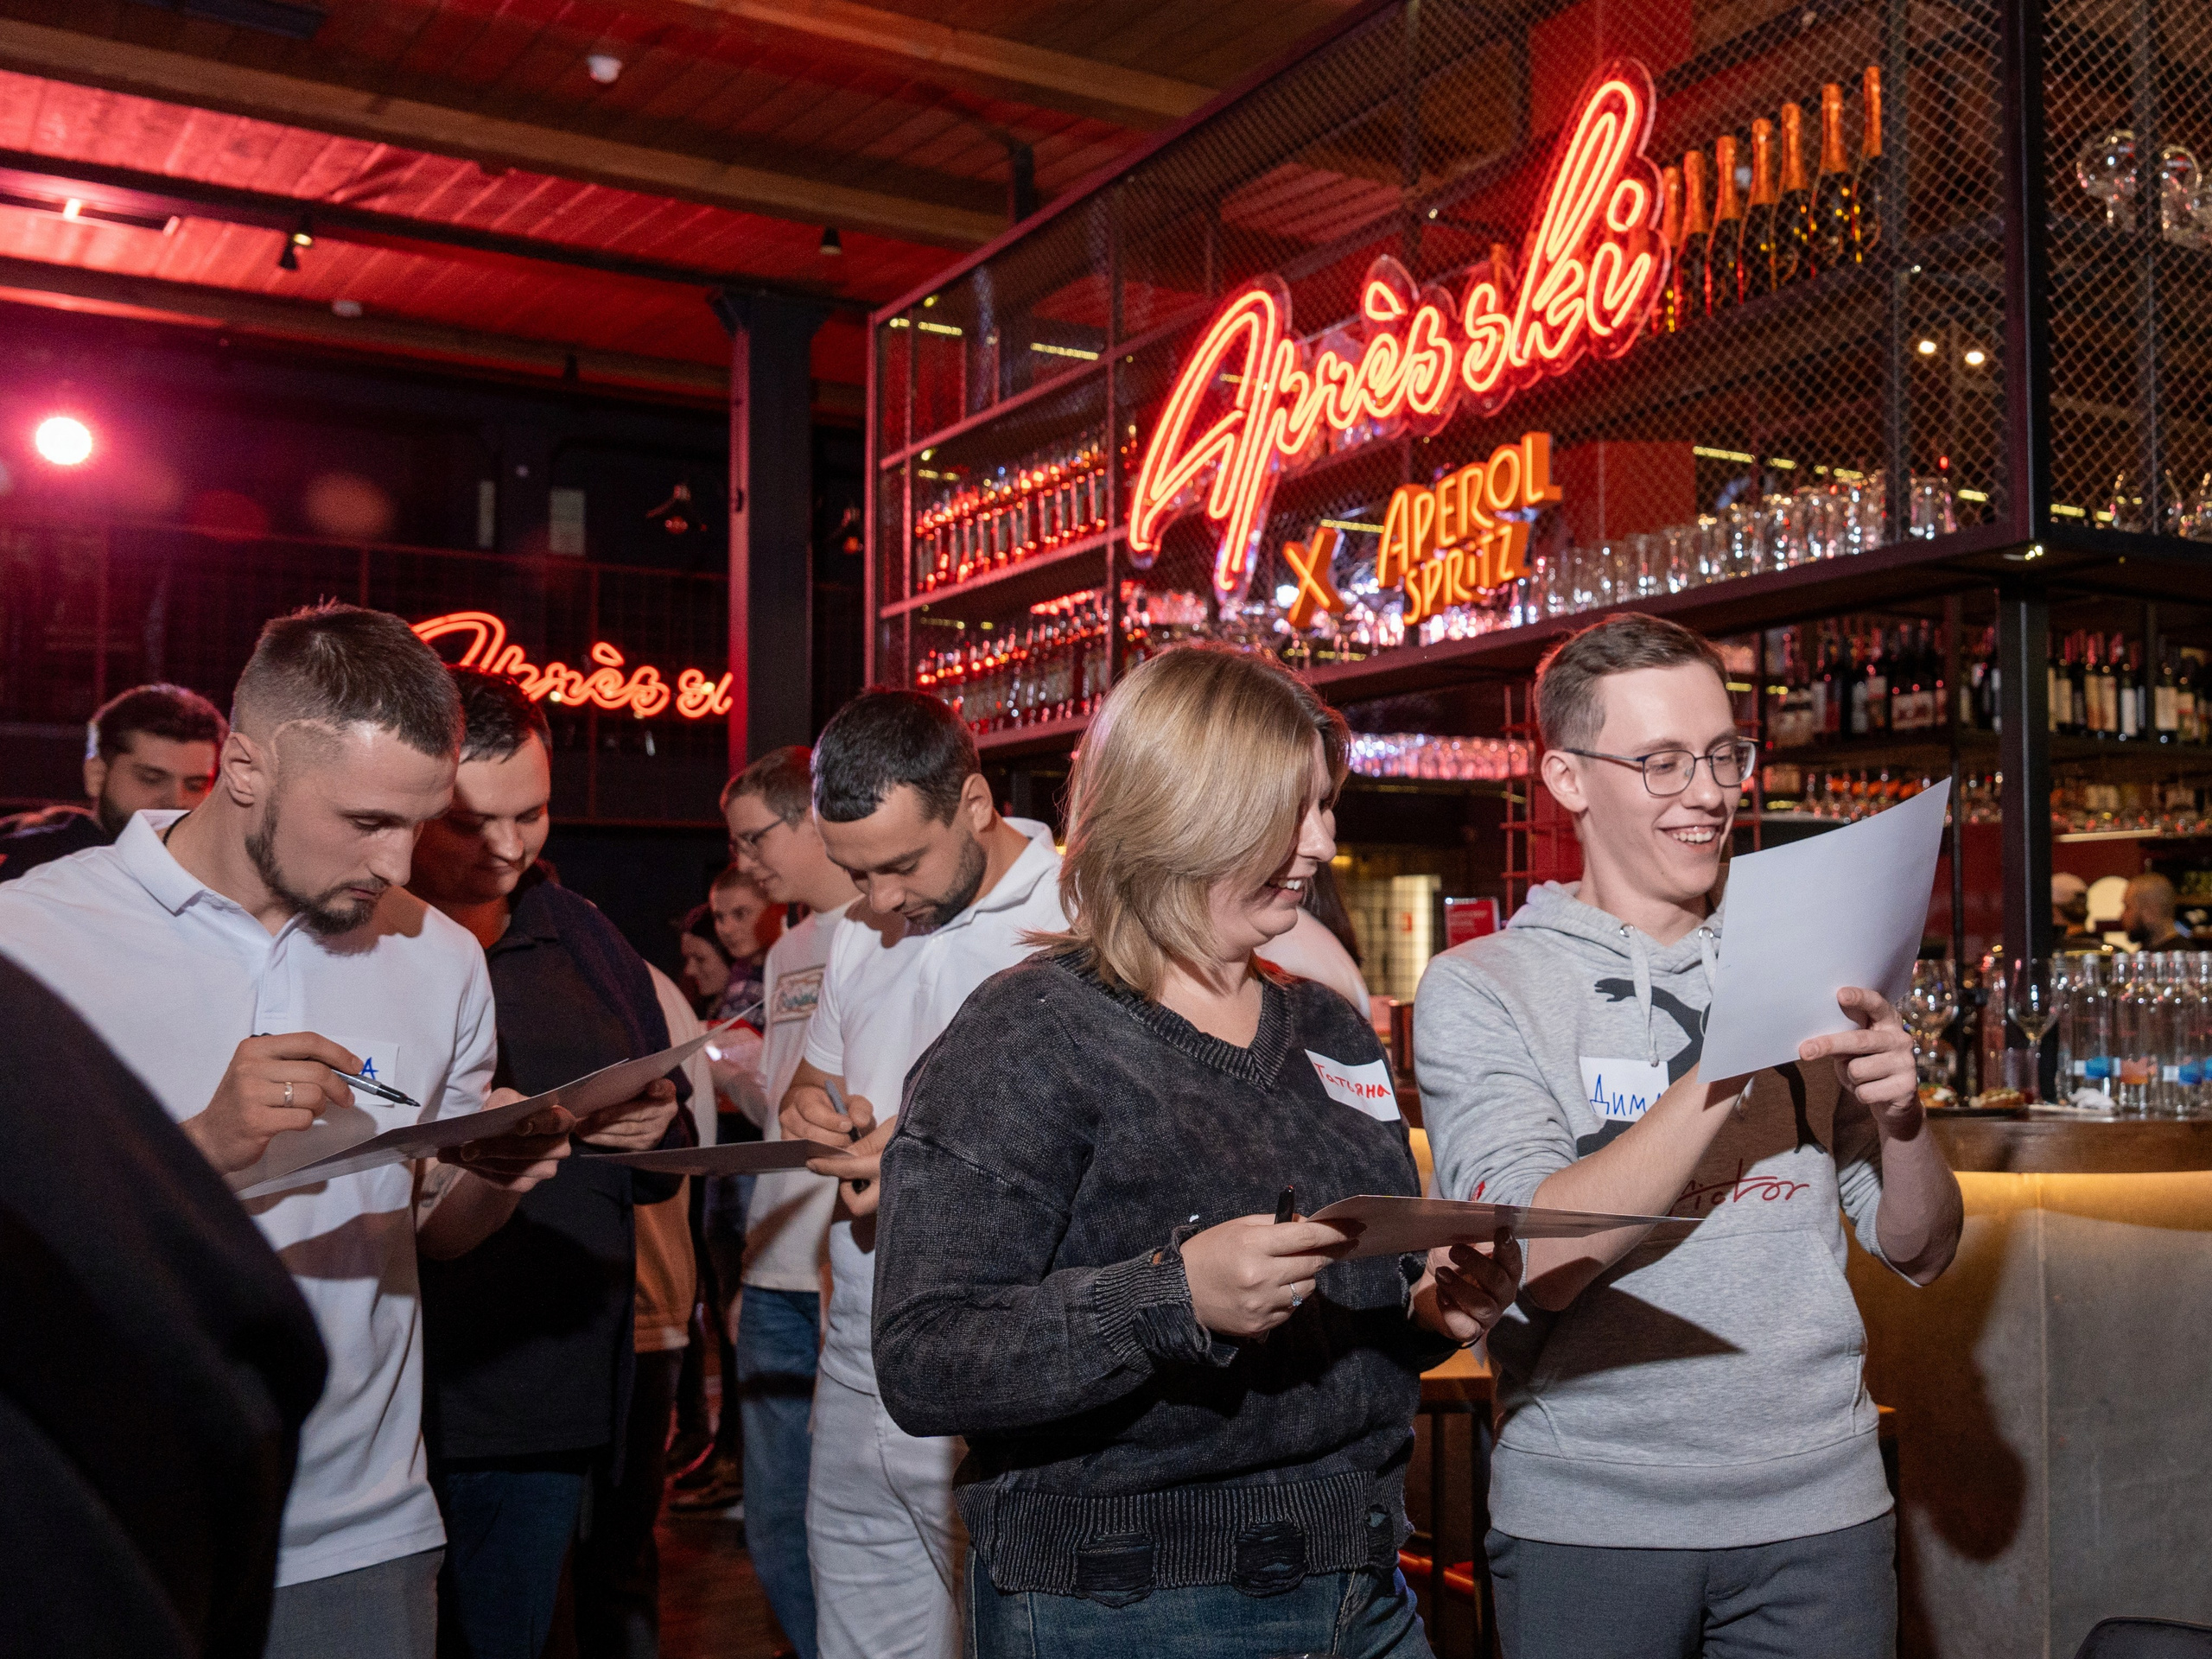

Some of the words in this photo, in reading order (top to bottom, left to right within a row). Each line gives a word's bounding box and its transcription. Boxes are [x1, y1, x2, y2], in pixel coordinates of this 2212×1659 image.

[1460, 78, 1654, 393] ski
[1376, 431, 1562, 588] APEROL
[1589, 1073, 1661, 1116] Дим
